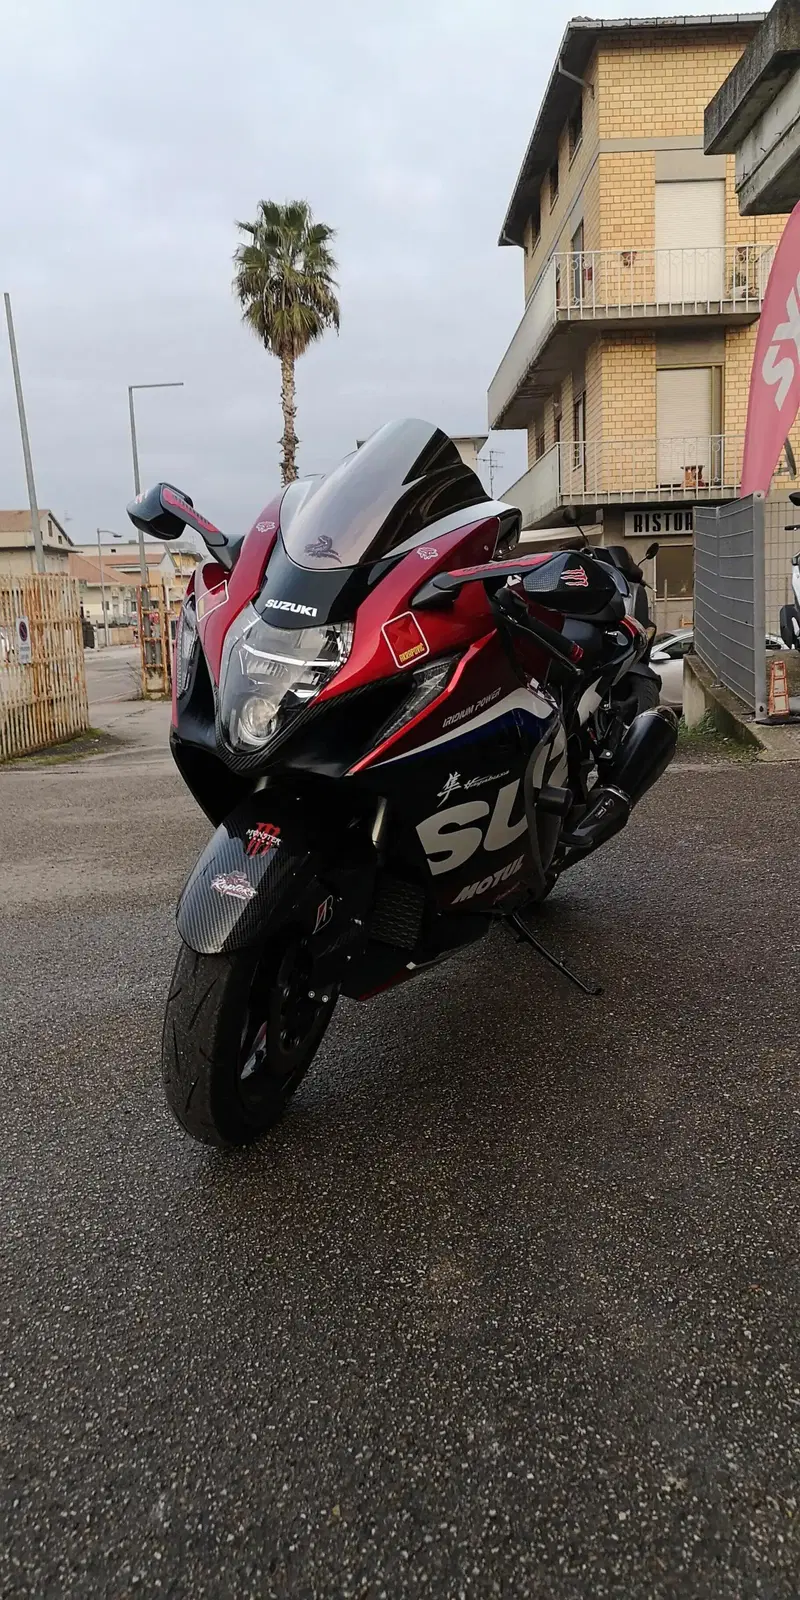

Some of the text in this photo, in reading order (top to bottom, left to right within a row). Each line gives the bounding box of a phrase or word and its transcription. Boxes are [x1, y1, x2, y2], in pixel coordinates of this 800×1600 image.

[265, 598, 318, 617] SUZUKI
[442, 686, 502, 728] IRIDIUM POWER
[245, 828, 282, 846] MONSTER
[451, 854, 525, 905] MOTUL
